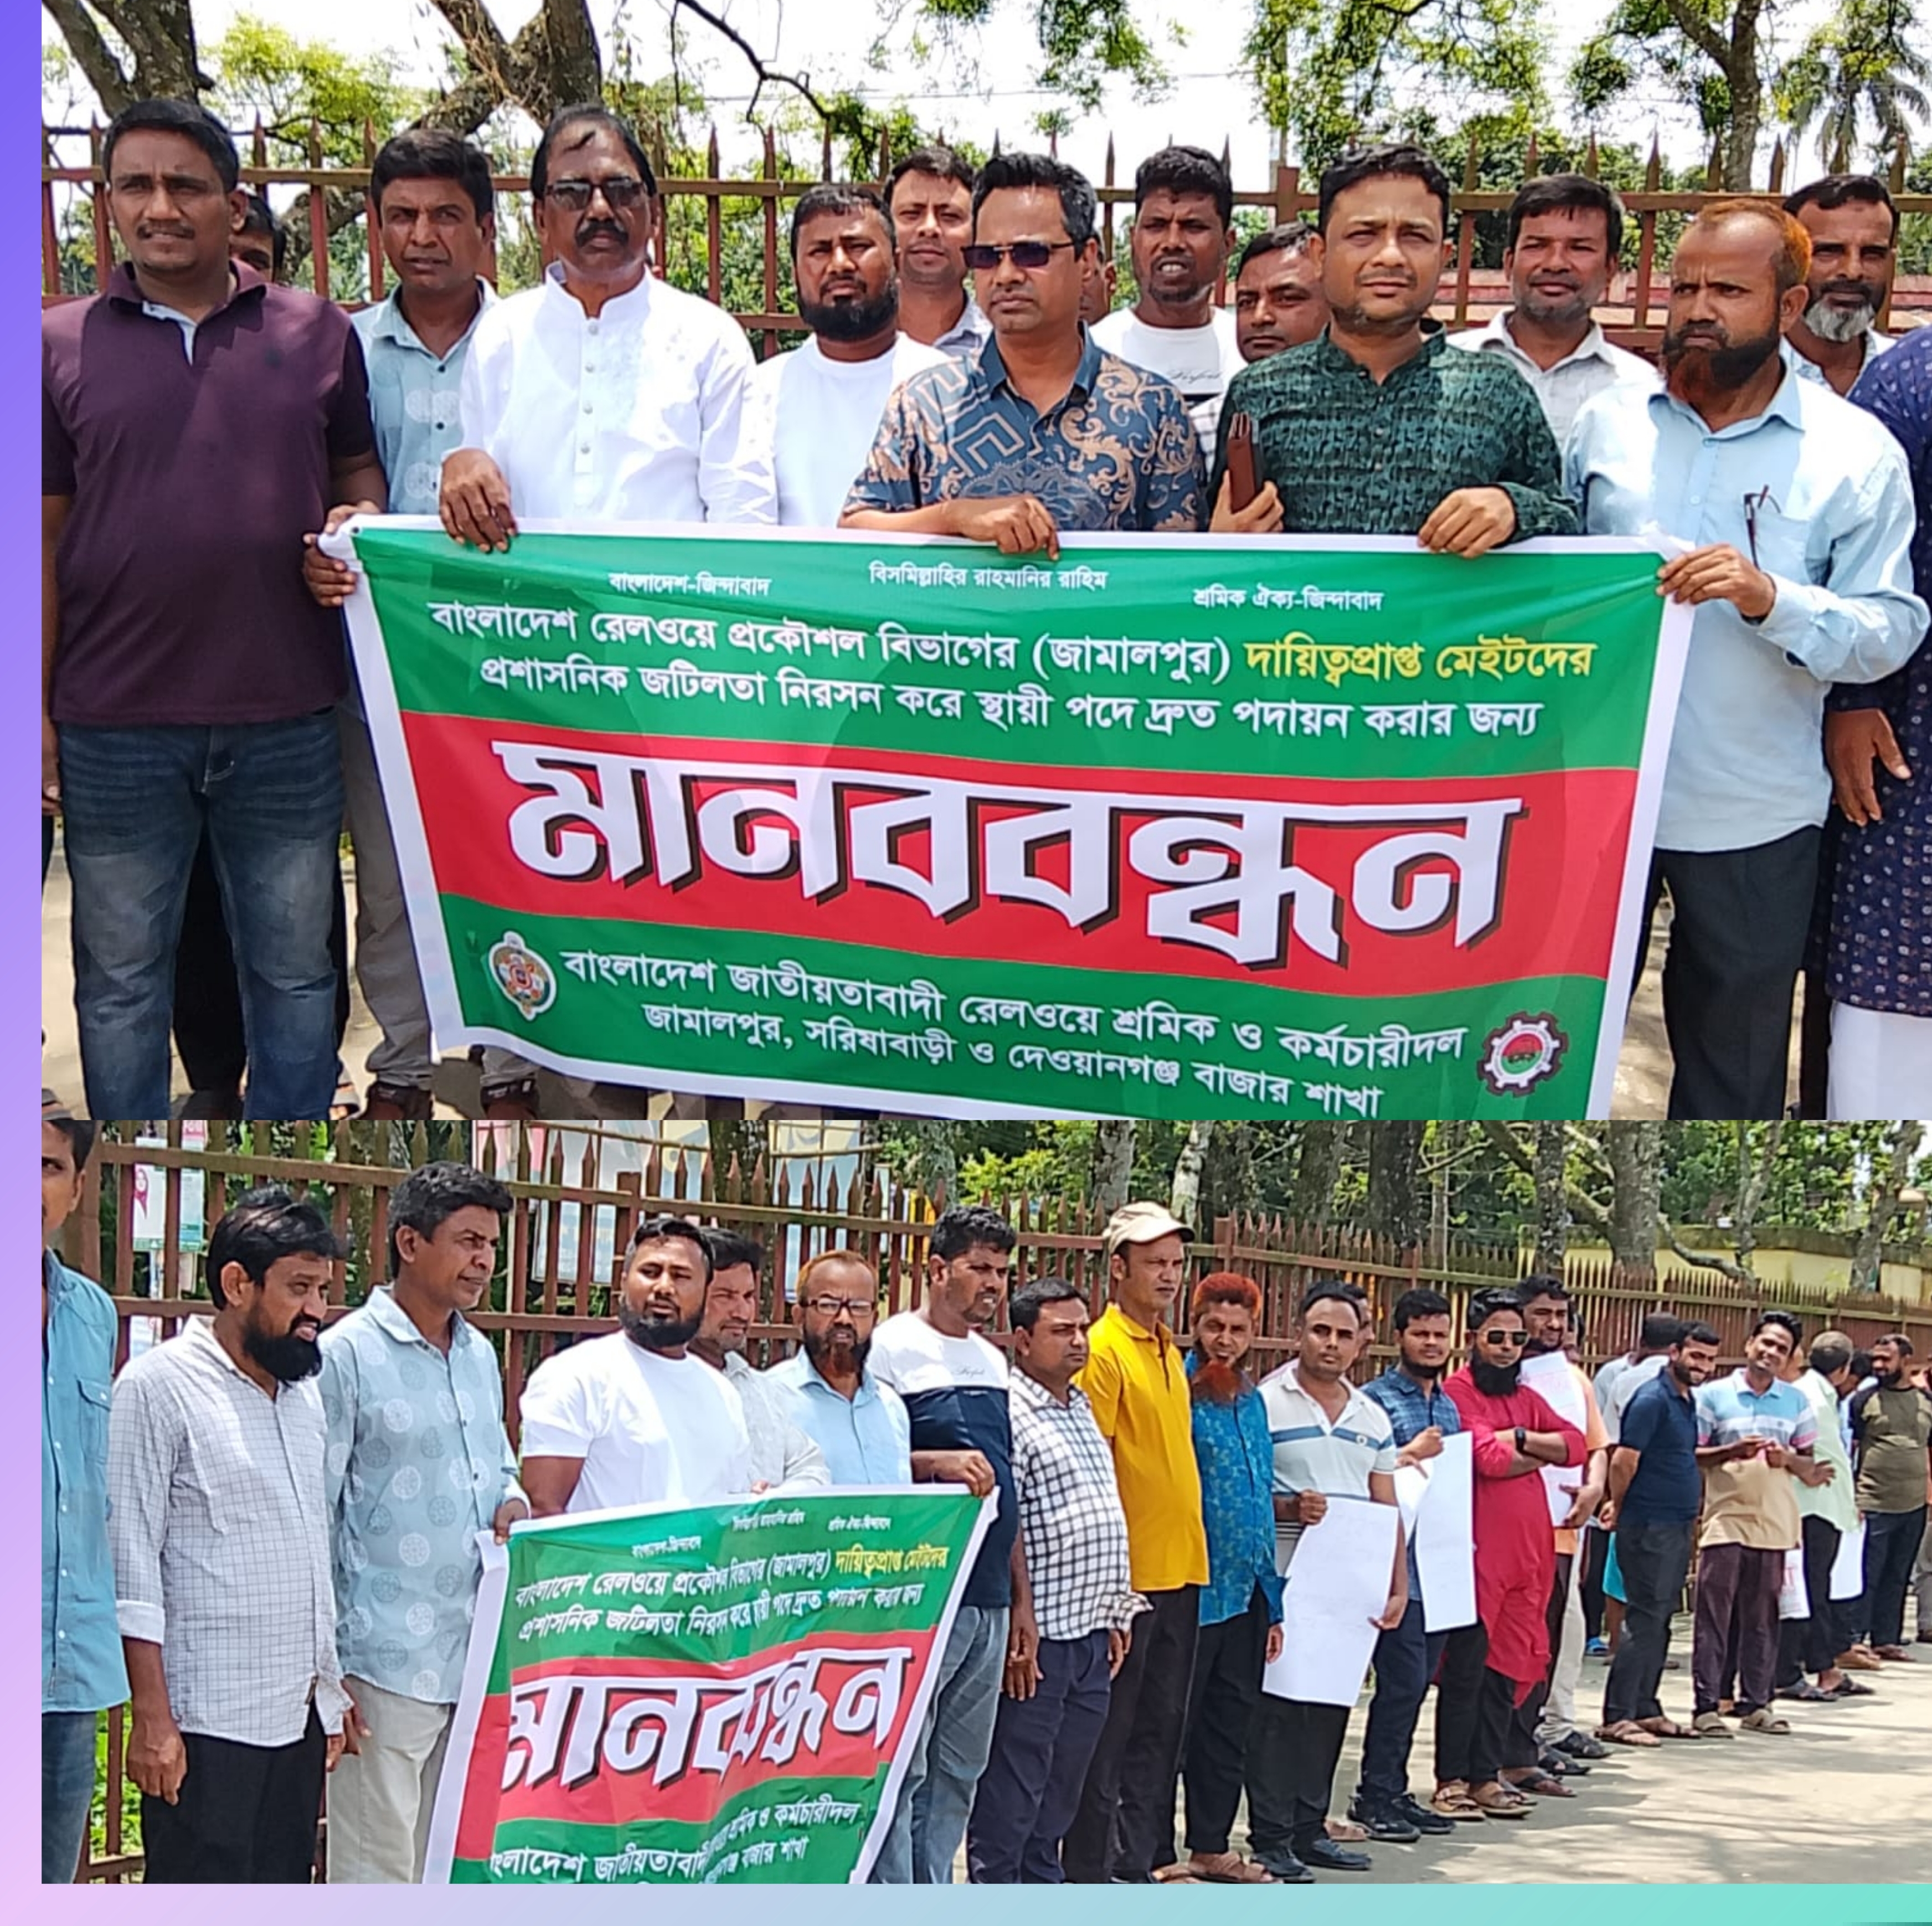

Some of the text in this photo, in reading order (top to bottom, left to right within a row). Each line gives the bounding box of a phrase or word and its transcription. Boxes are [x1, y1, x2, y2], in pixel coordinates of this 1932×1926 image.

[608, 570, 771, 596] বাংলাদেশ-জিন্দাবাদ
[868, 560, 1108, 590] বিসমিল্লাহির রাহমানির রাহিম
[1193, 582, 1383, 608] শ্রমিক ঐক্য-জিন্দাবাদ
[427, 601, 1597, 687] বাংলাদেশ রেলওয়ে প্রকৌশল বিভাগের (জামালপুর) দায়িত্বপ্রাপ্ত মেইটদের
[480, 652, 1544, 736] প্রশাসনিক জটিলতা নিরসন করে স্থায়ী পদে দ্রুত পদায়ন করার জন্য
[492, 739, 1525, 964] মানববন্ধন
[559, 949, 1468, 1070] বাংলাদেশ জাতীয়তাবাদী রেলওয়ে শ্রমিক ও কর্মচারীদল
[642, 1004, 1384, 1118] জামালপুর, সরিষাবাড়ী ও দেওয়ানগঞ্জ বাজার শাখা
[593, 1571, 672, 1597] রেলওয়ে
[490, 1845, 589, 1882] াংলাদেশ
